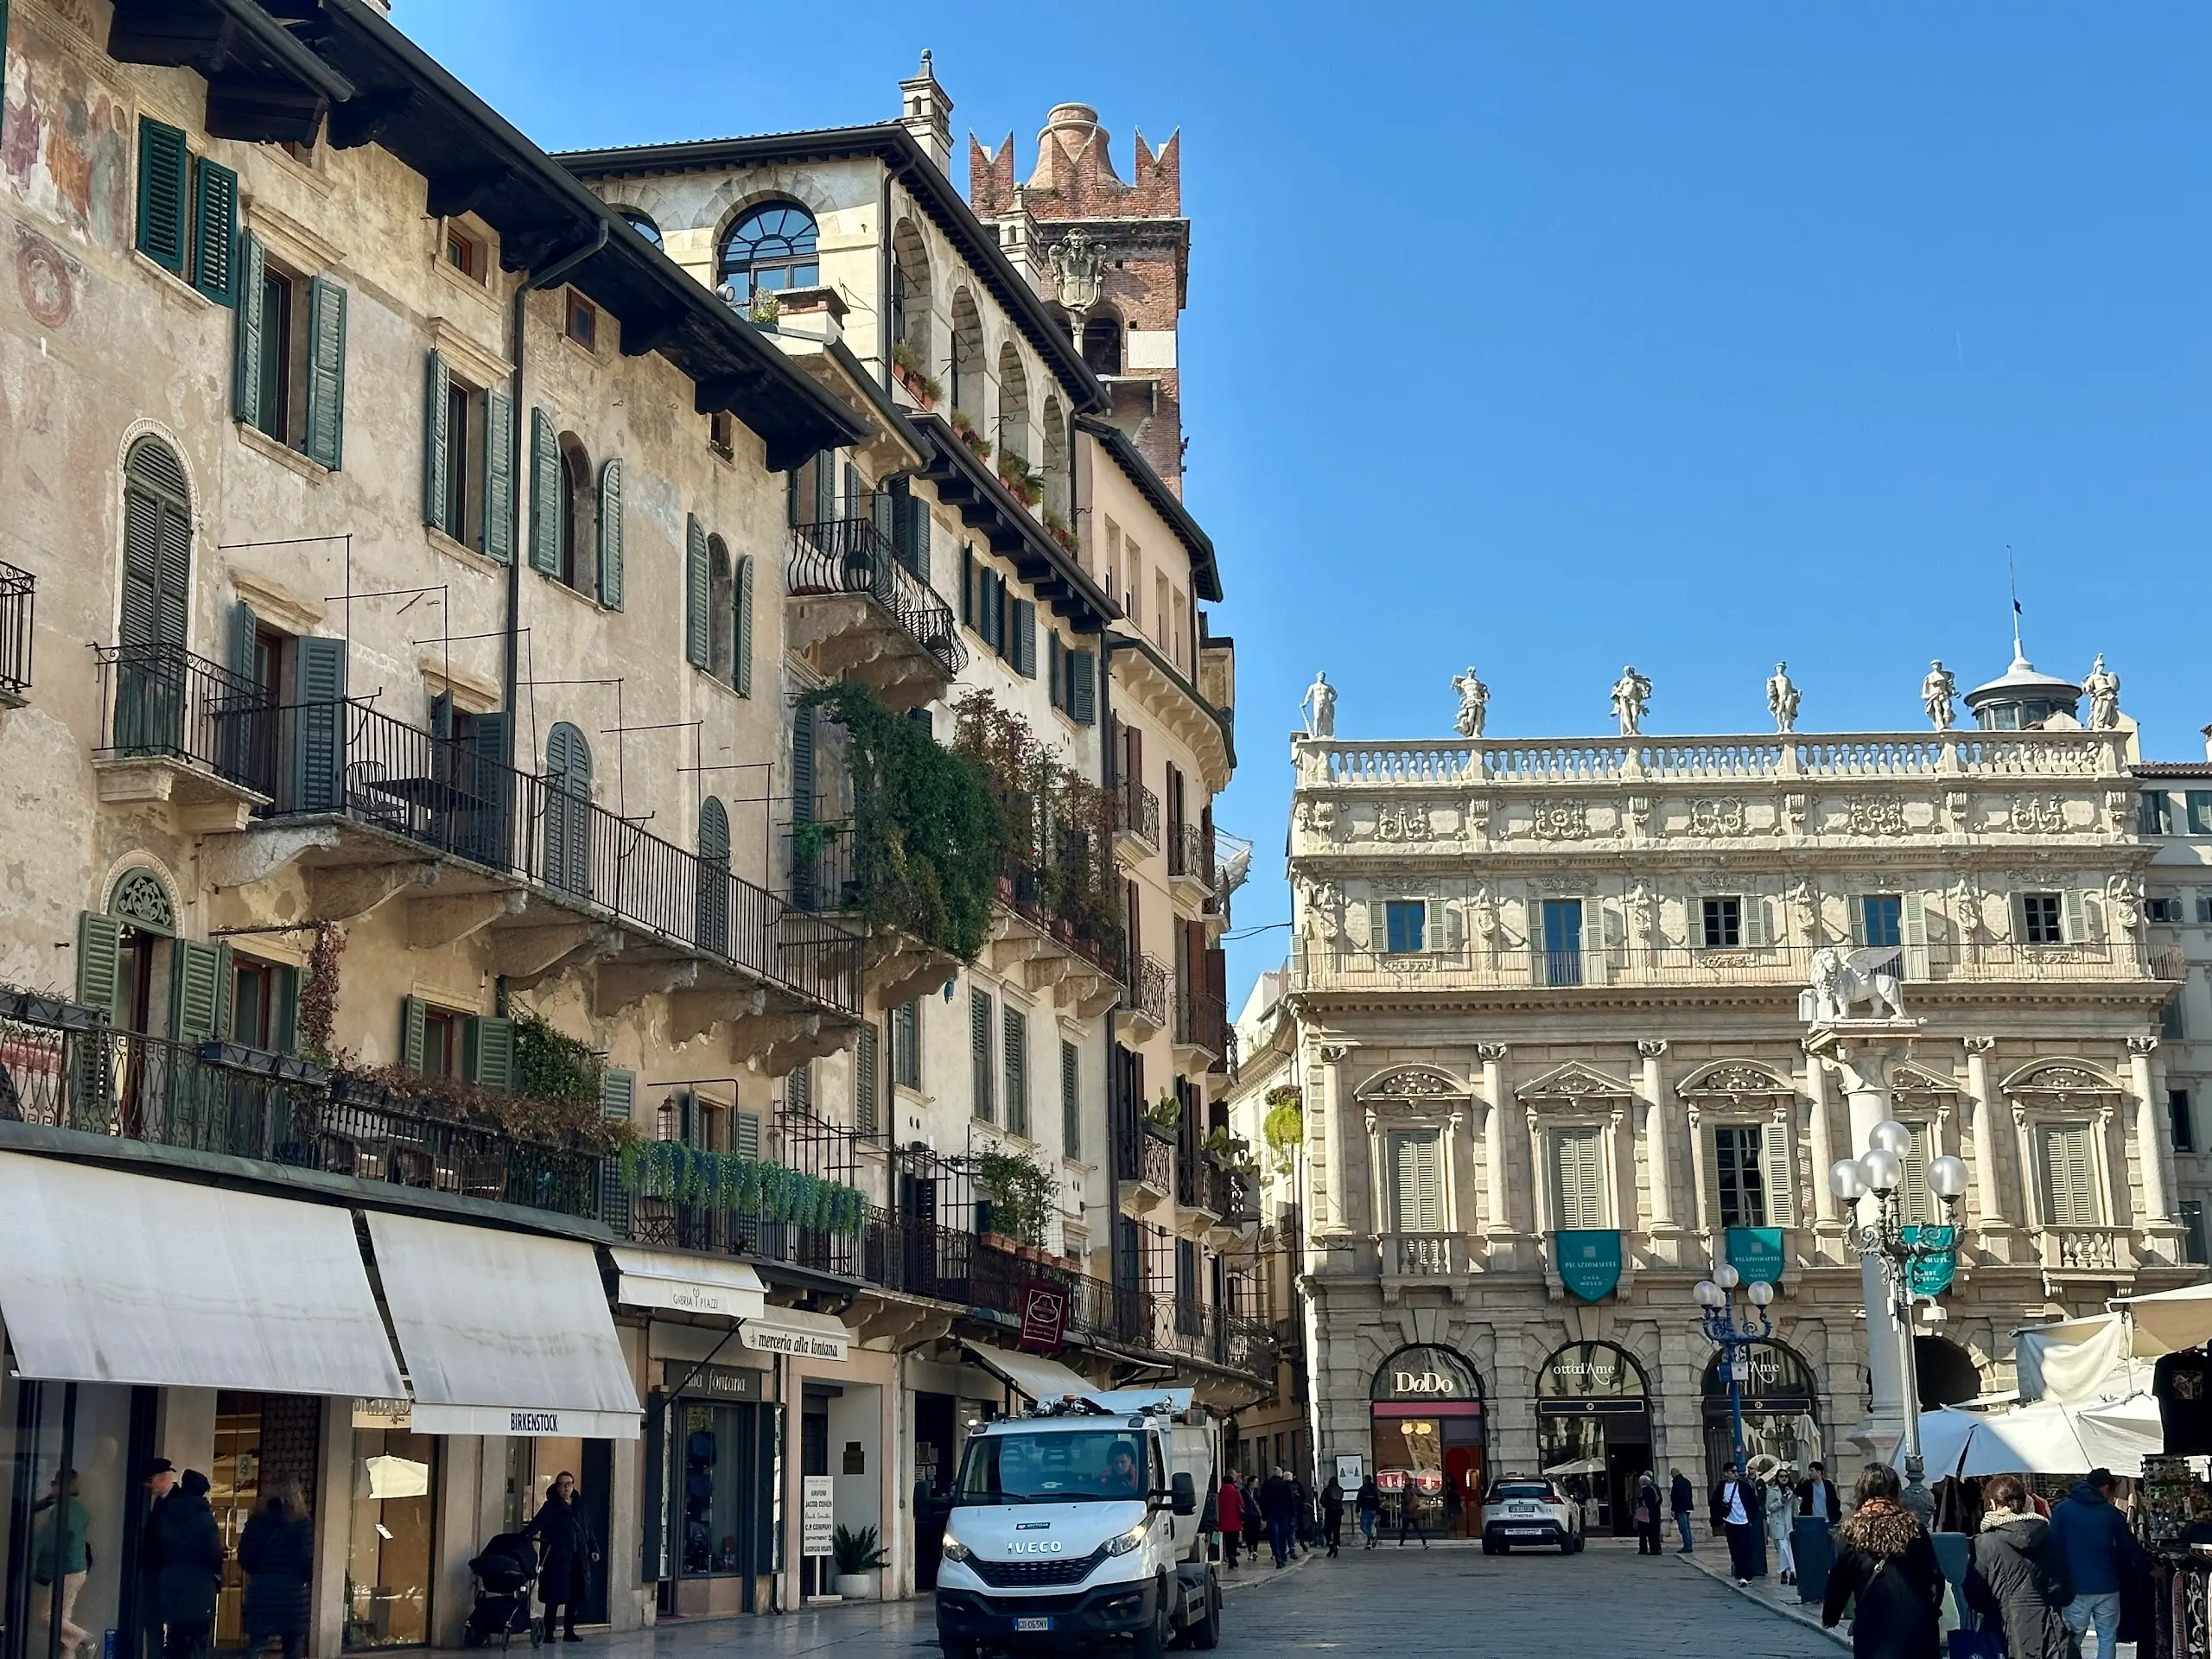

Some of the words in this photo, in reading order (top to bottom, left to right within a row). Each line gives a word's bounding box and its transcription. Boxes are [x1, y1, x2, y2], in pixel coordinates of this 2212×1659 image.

[759, 1333, 791, 1351] merceria
[794, 1336, 809, 1354] alla
[811, 1338, 839, 1357] fontana
[707, 1368, 746, 1395] fontana
[1395, 1371, 1453, 1393] DoDo
[511, 1412, 558, 1433] BIRKENSTOCK
[1007, 1541, 1063, 1554] IVECO
